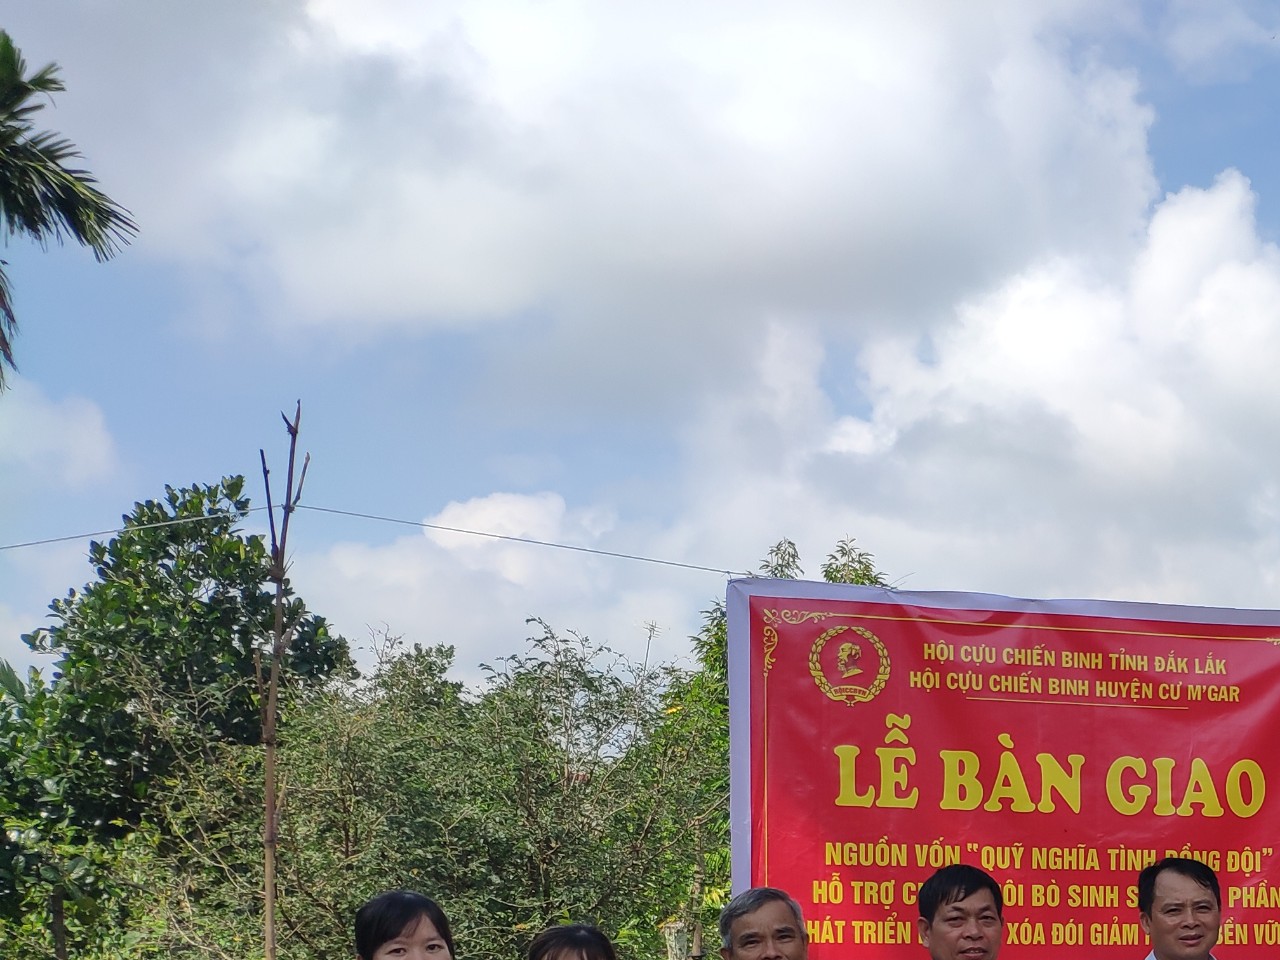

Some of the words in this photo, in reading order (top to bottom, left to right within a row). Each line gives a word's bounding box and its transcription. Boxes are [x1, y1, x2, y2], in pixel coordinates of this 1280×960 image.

[923, 639, 954, 665] HỘI
[960, 643, 996, 666] CỰU
[1002, 643, 1056, 667] CHIẾN
[1061, 651, 1103, 670] BINH
[1108, 647, 1148, 672] TỈNH
[1154, 650, 1189, 674] ĐẮK
[1194, 652, 1227, 675] LẮK
[909, 667, 940, 693] HỘI
[946, 670, 983, 694] CỰU
[988, 670, 1042, 694] CHIẾN
[1048, 677, 1089, 697] BINH
[1095, 677, 1153, 703] HUYỆN
[1158, 681, 1183, 701] CƯ
[833, 713, 919, 810] LỄ
[939, 733, 1086, 815] BÀN
[1105, 755, 1267, 819] GIAO
[825, 835, 908, 868] NGUỒN
[914, 836, 961, 868] VỐN
[1031, 843, 1101, 871] NGHĨA
[1107, 844, 1157, 871] TÌNH
[812, 872, 844, 905] HỖ
[850, 879, 897, 910] TRỢ
[1031, 879, 1060, 908] BÒ
[1067, 885, 1119, 908] SINH
[803, 915, 846, 944] HÁT
[851, 911, 911, 945] TRIỂN
[1006, 917, 1046, 945] XÓA
[1051, 918, 1084, 946] ĐÓI
[1090, 915, 1139, 946] GIẢM
